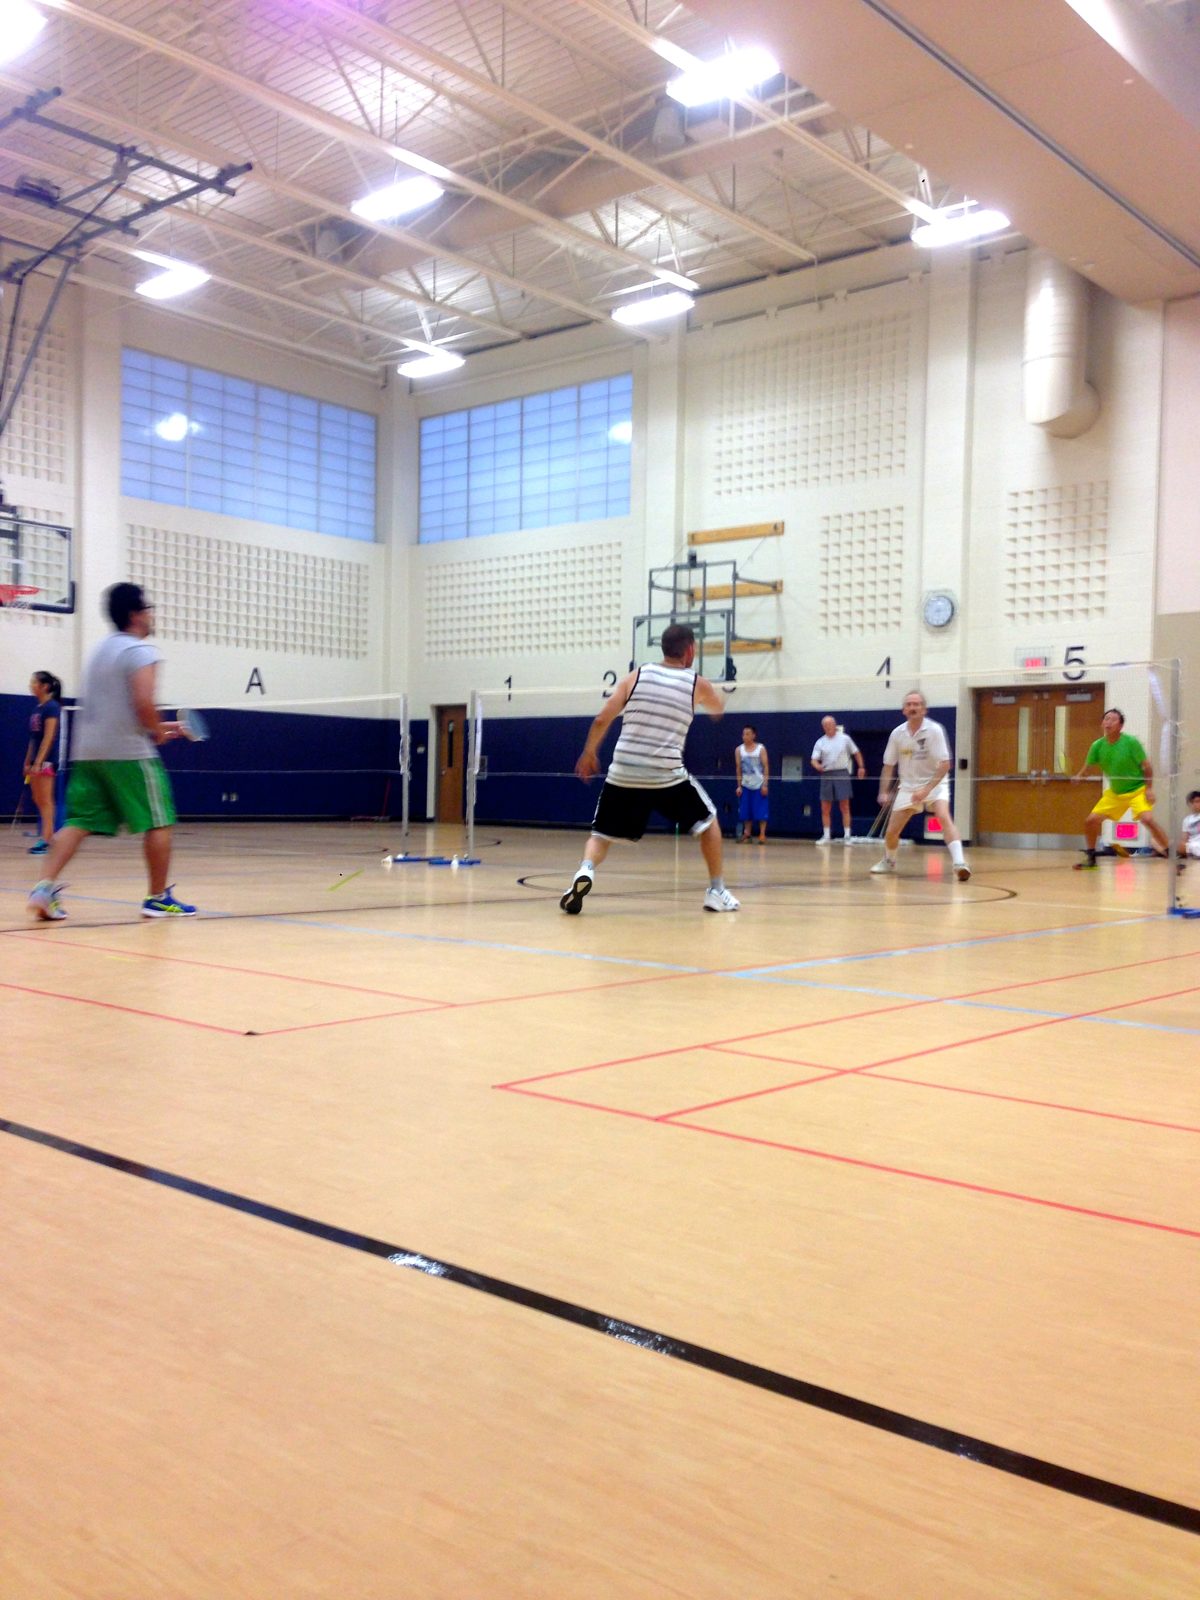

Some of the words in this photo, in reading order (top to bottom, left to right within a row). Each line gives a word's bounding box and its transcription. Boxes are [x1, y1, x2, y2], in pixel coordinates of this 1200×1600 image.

[1062, 646, 1086, 680] 5
[245, 667, 266, 695] A
[504, 675, 512, 701] 1
[602, 670, 617, 698] 2
